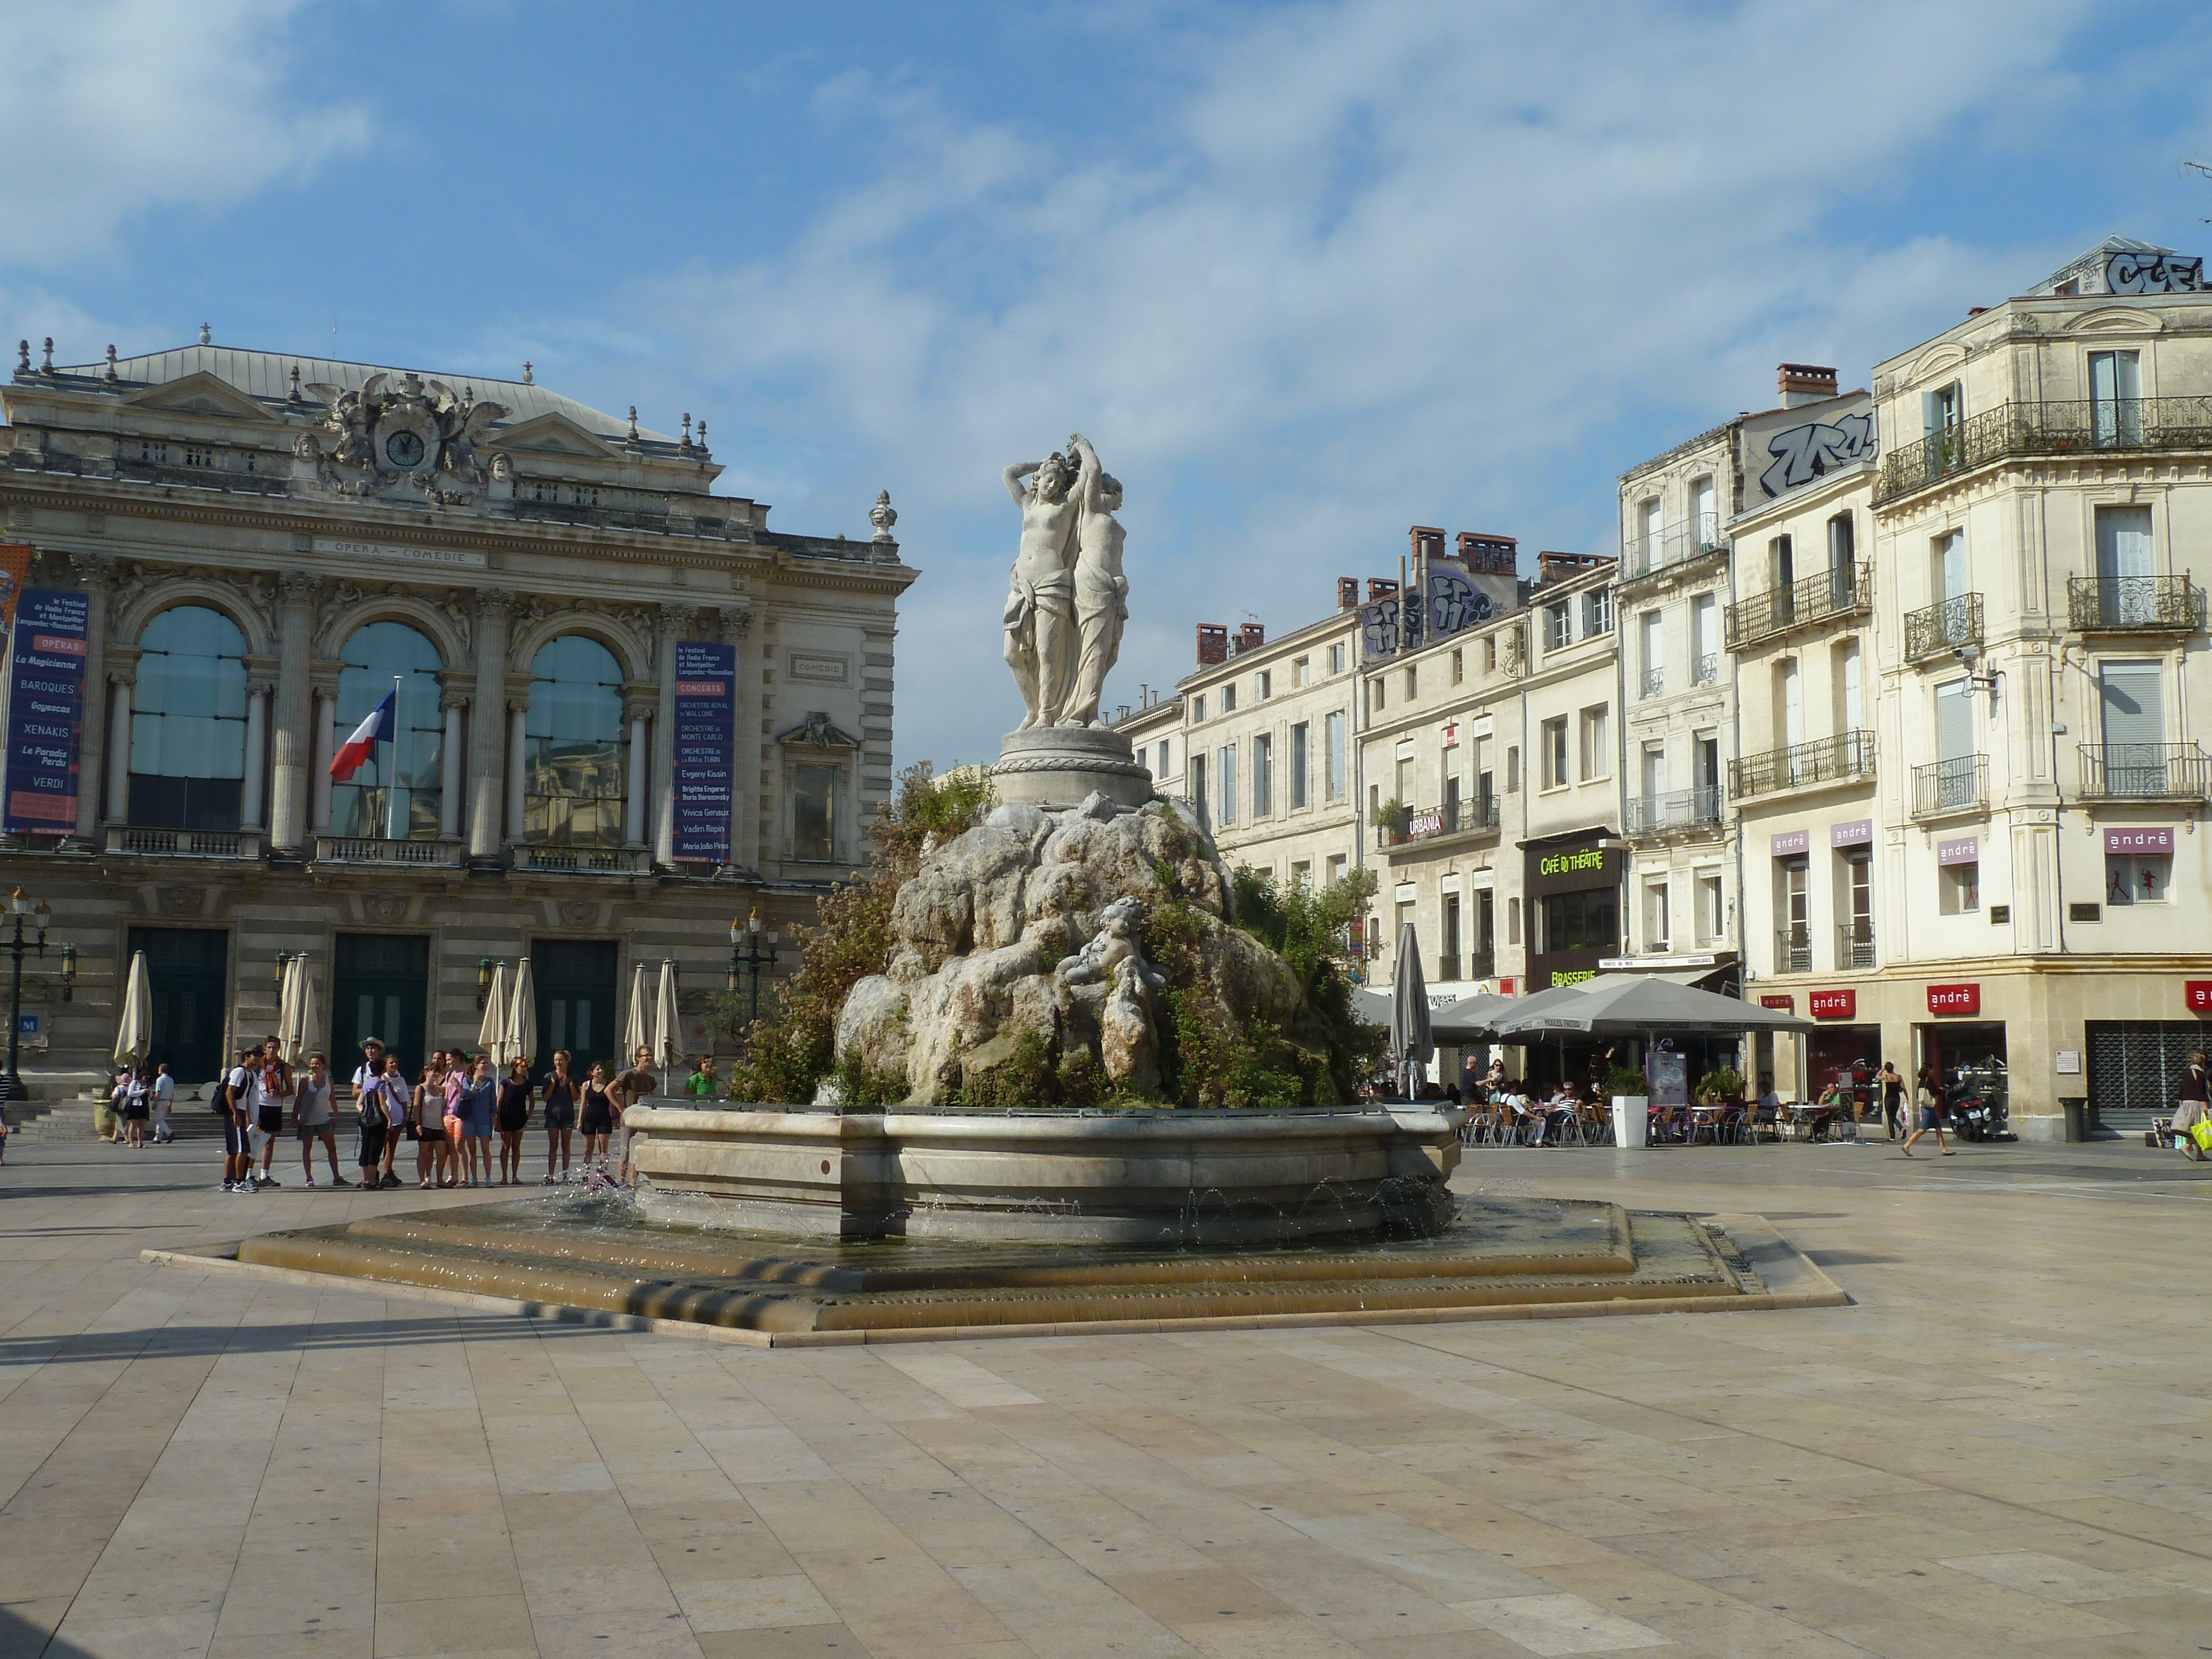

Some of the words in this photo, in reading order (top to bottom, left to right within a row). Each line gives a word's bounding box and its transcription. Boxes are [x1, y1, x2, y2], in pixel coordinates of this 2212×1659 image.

[335, 542, 380, 555] OPERA
[403, 549, 466, 562] COMEDIE
[62, 598, 87, 608] Festival
[45, 604, 62, 613] Radio
[65, 607, 86, 615] France
[49, 613, 85, 624] Montpellier
[42, 639, 79, 651] OPÉRAS
[15, 654, 27, 664] La
[28, 656, 76, 669] Magicienne
[799, 664, 839, 672] COMEDIE
[21, 679, 74, 694] BAROQUES
[31, 701, 71, 713] Goyescas
[24, 724, 69, 737] XENAKIS
[23, 745, 33, 755] Le
[35, 747, 67, 758] Paradis
[41, 757, 67, 766] Perdu
[682, 770, 706, 779] Evgeny
[33, 777, 64, 789] VERDI
[704, 808, 729, 816] Genaux
[683, 825, 705, 833] Vadim
[706, 825, 724, 834] Repin
[1410, 816, 1441, 834] URBANIA
[1569, 848, 1604, 870] THÉÂTRE
[1551, 970, 1597, 987] BRASSERIE
